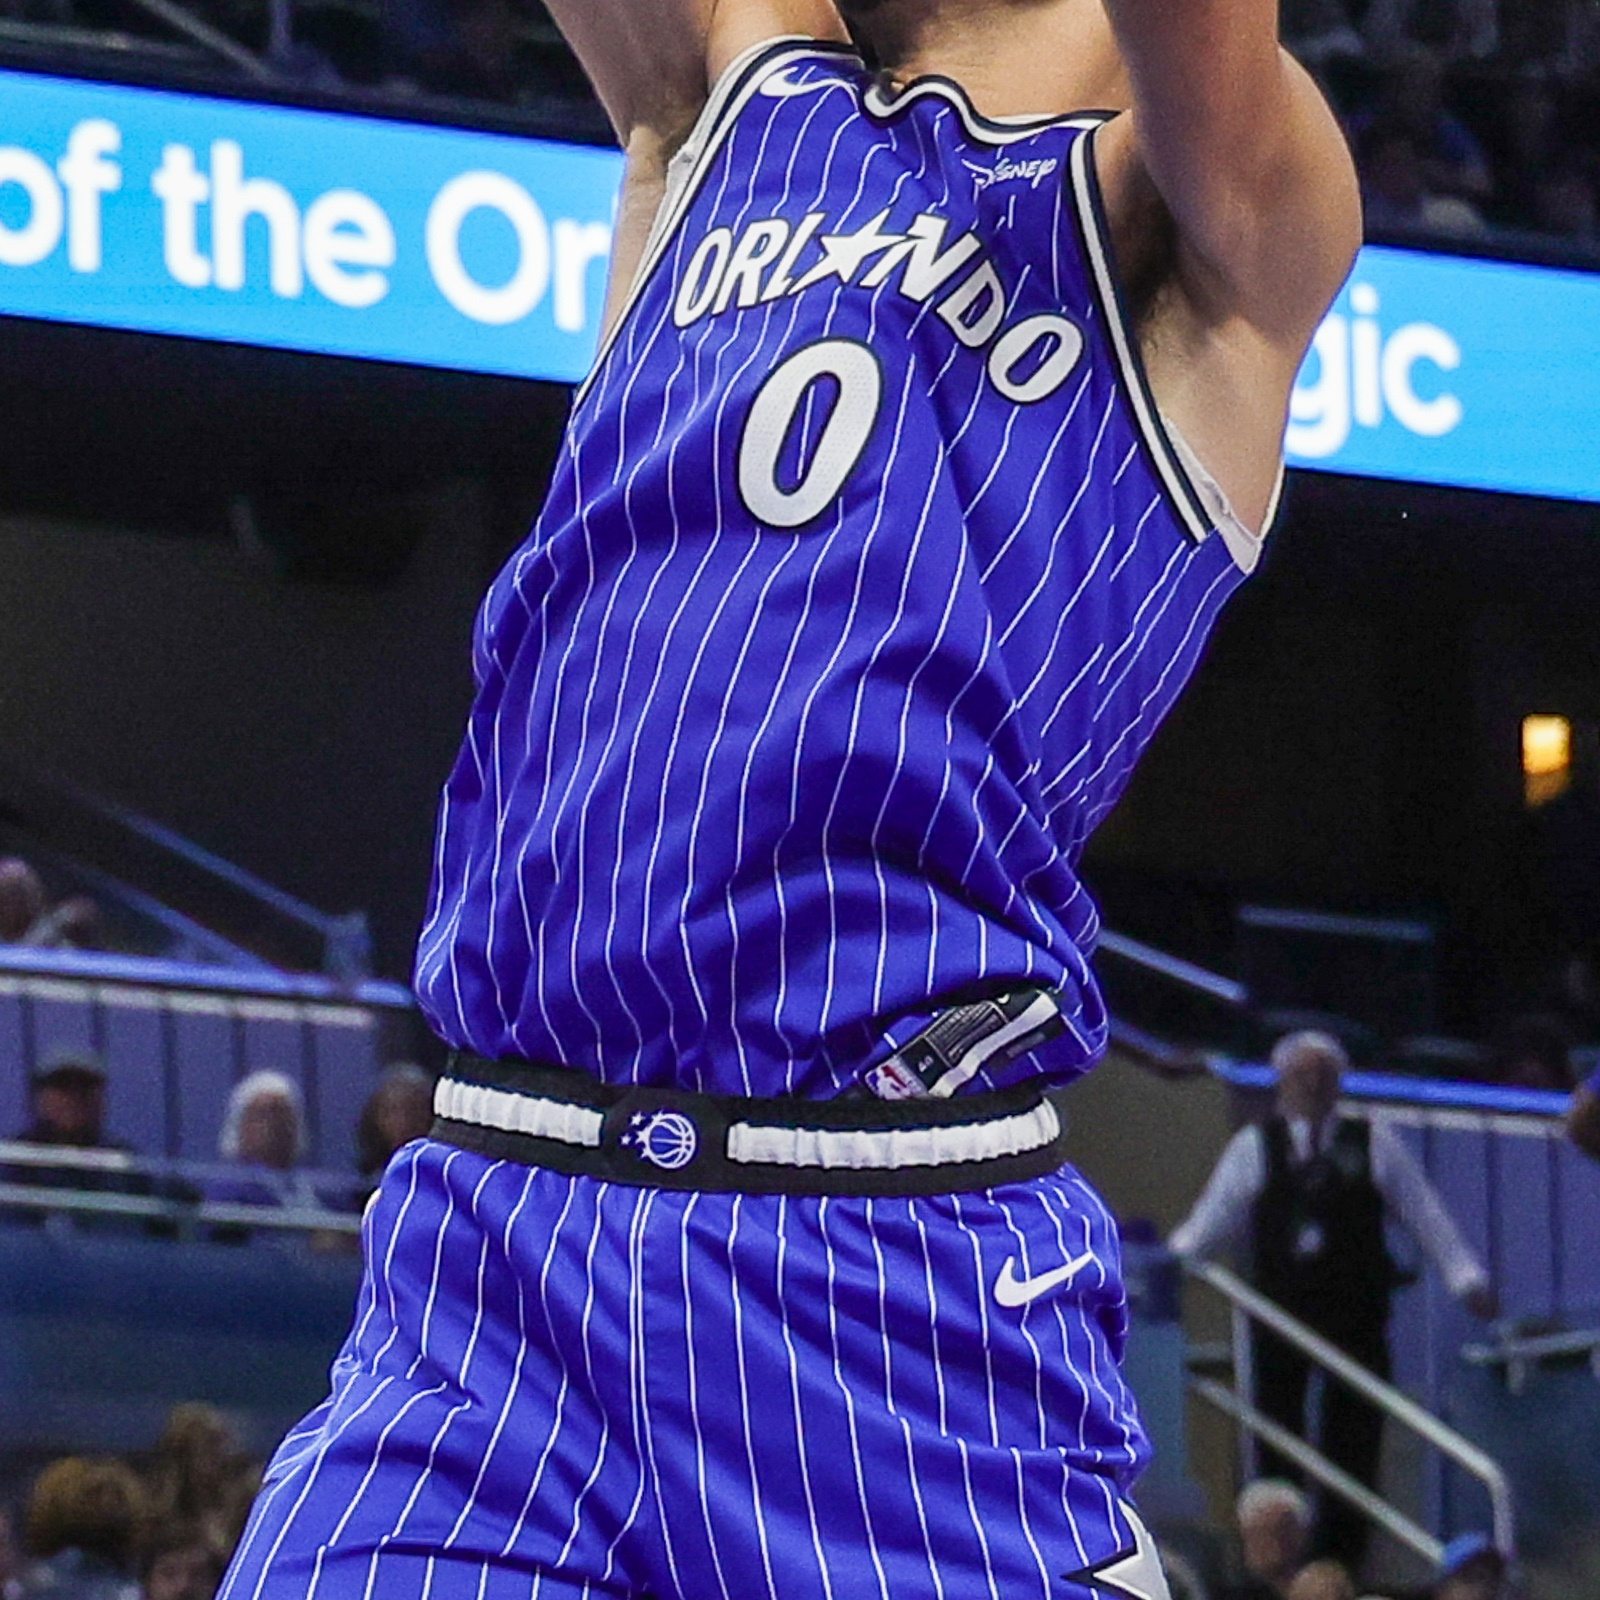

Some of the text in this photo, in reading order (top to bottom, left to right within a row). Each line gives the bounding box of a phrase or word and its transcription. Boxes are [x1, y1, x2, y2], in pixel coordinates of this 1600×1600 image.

[152, 140, 396, 308] the
[426, 170, 616, 332] Or
[736, 336, 882, 528] 0
